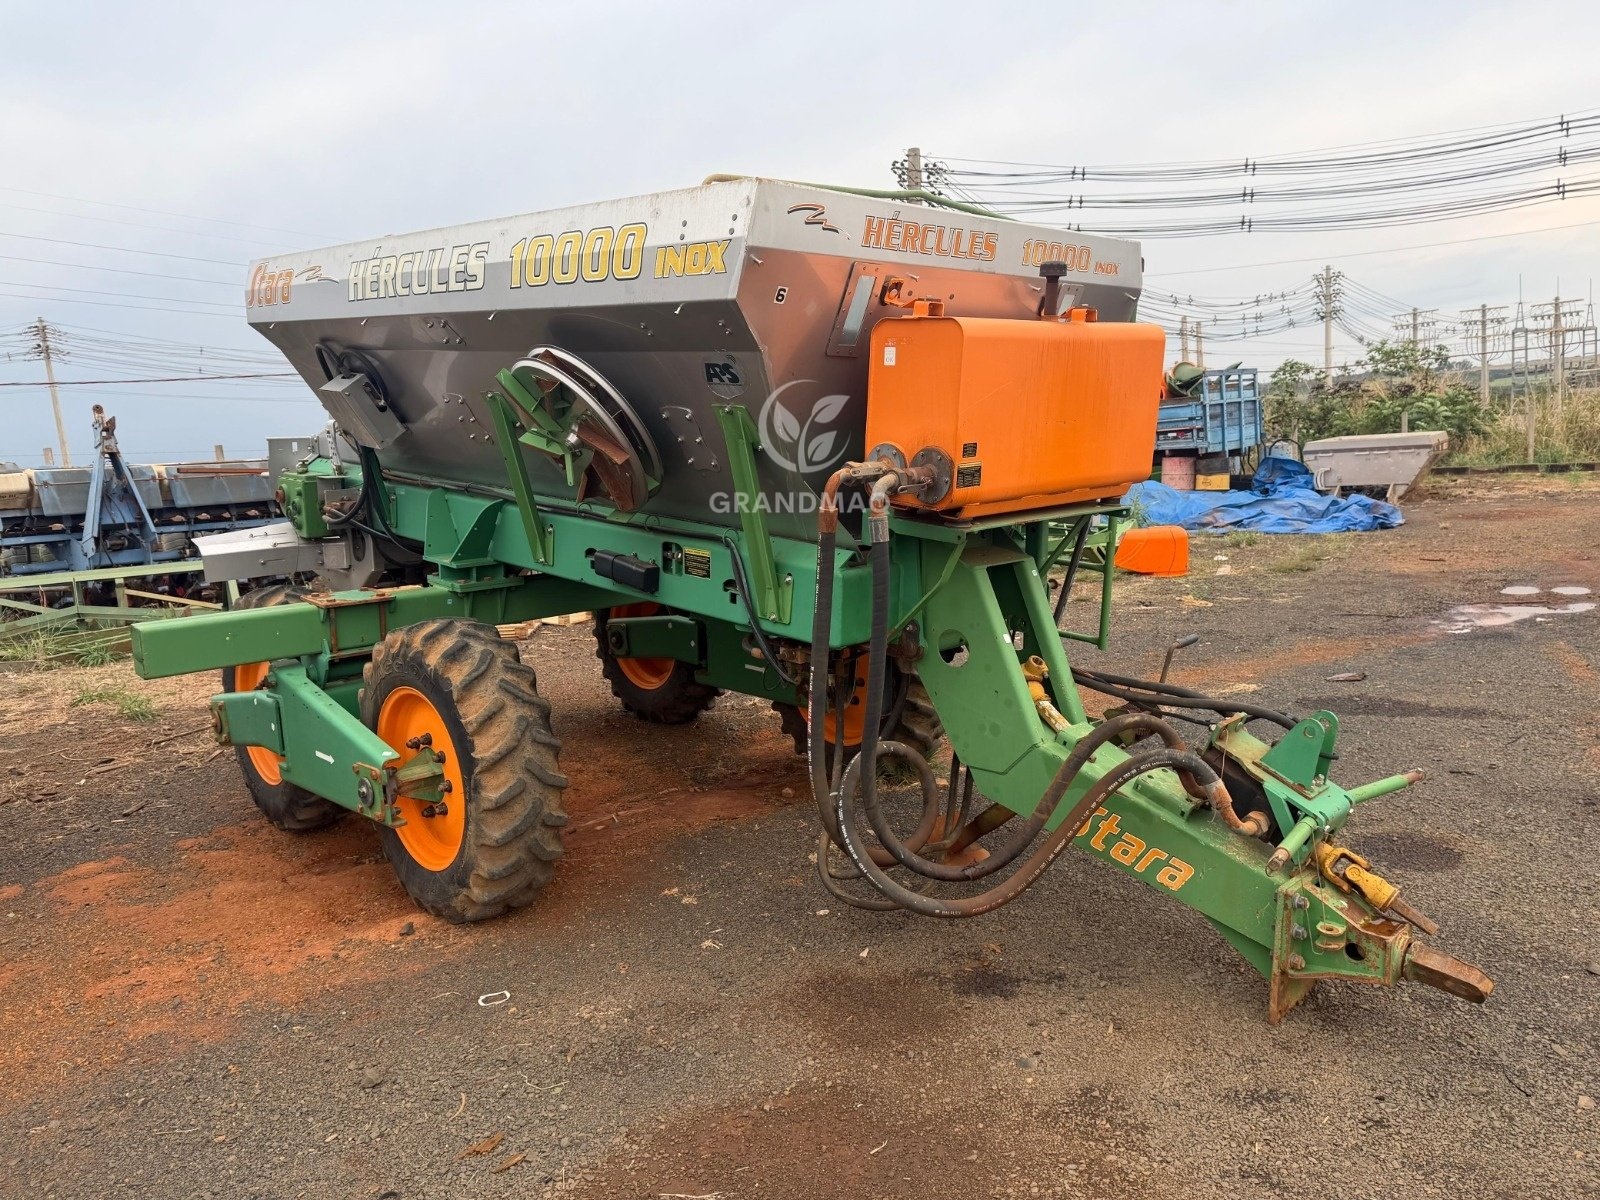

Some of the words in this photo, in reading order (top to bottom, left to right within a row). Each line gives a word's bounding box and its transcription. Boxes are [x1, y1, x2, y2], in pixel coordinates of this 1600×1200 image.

[348, 246, 490, 302] HÉRCULES
[510, 222, 648, 289] 10000
[654, 239, 732, 279] INOX
[861, 211, 998, 261] HÉRCULES
[1022, 239, 1091, 272] 10000
[1093, 260, 1120, 276] INOX
[246, 262, 294, 309] Stara
[775, 287, 787, 303] 6
